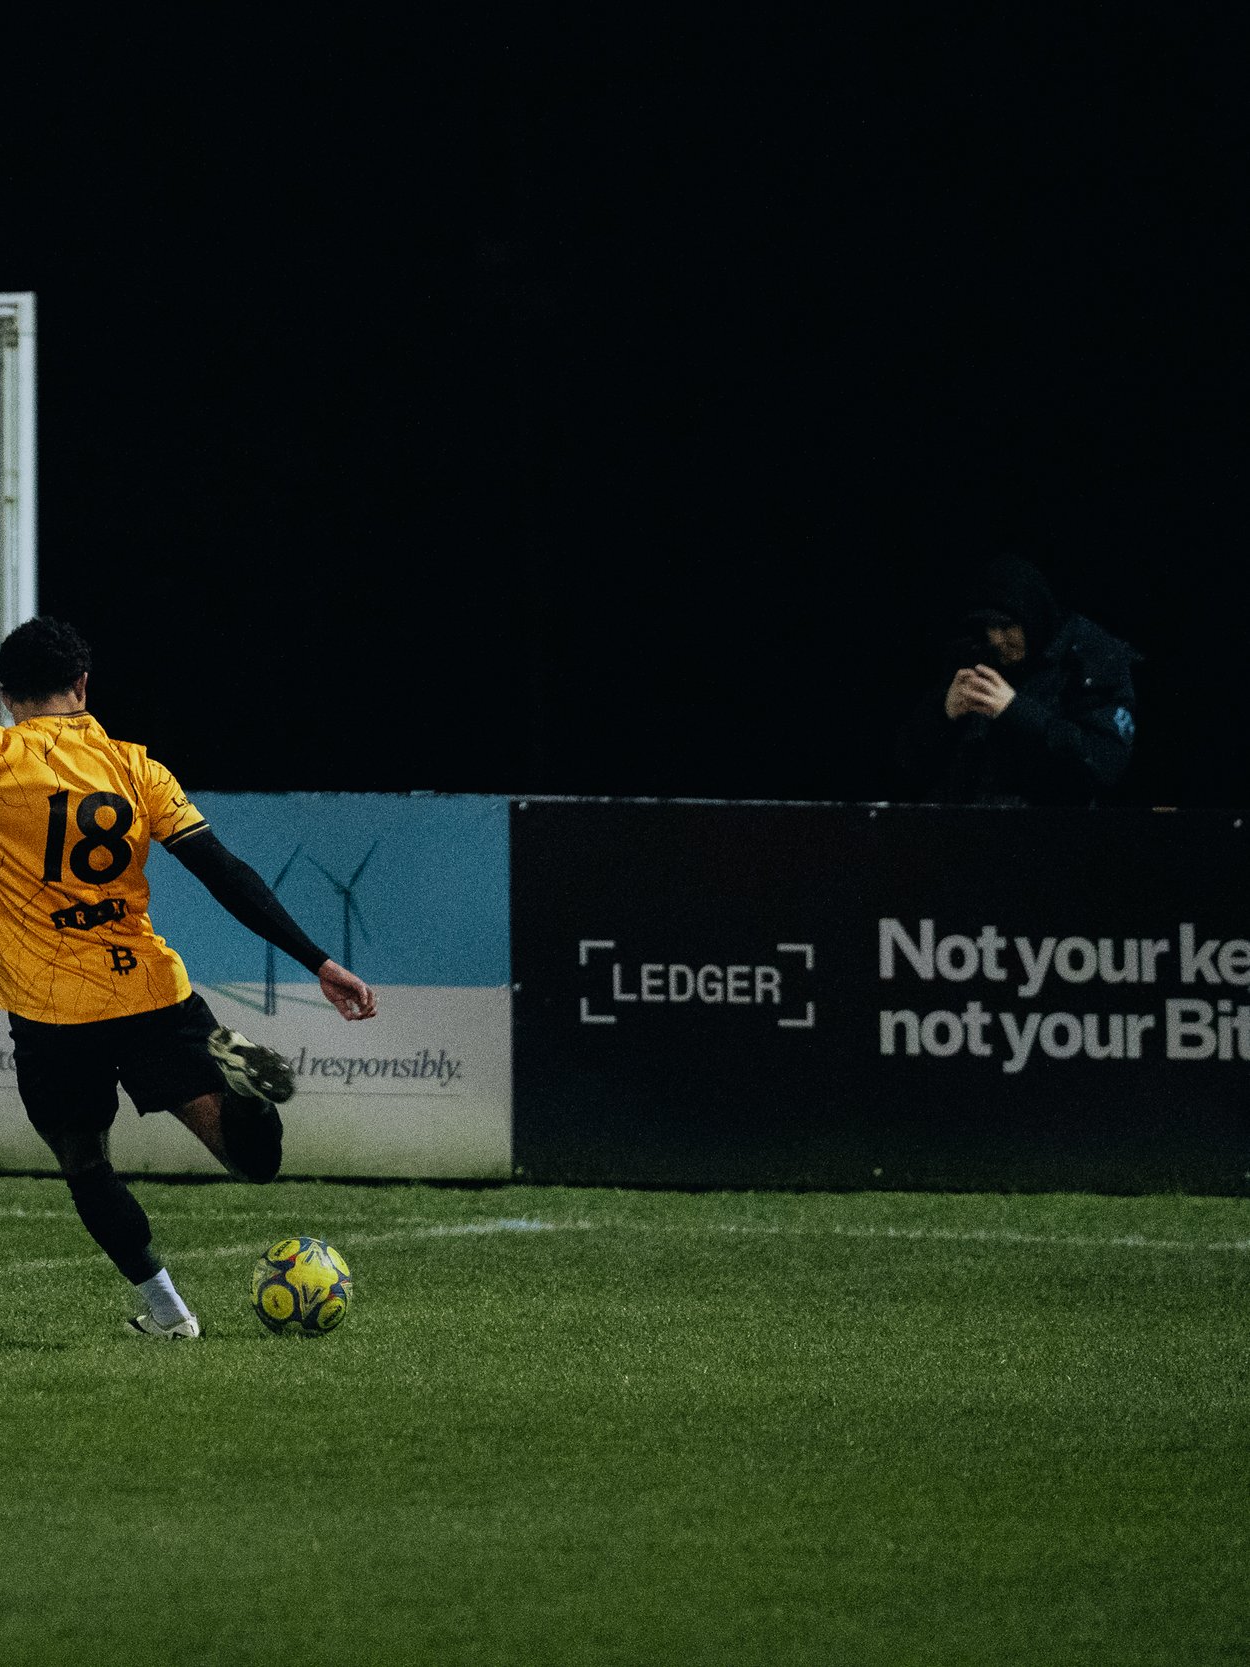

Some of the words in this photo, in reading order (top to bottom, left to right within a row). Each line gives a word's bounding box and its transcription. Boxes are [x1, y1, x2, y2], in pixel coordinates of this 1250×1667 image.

[43, 790, 134, 885] 18
[612, 963, 782, 1004] LEDGER
[878, 917, 1008, 982] Not
[1014, 935, 1170, 998] your
[310, 1048, 462, 1087] responsibly.
[879, 1001, 993, 1057] not
[999, 1011, 1156, 1074] your
